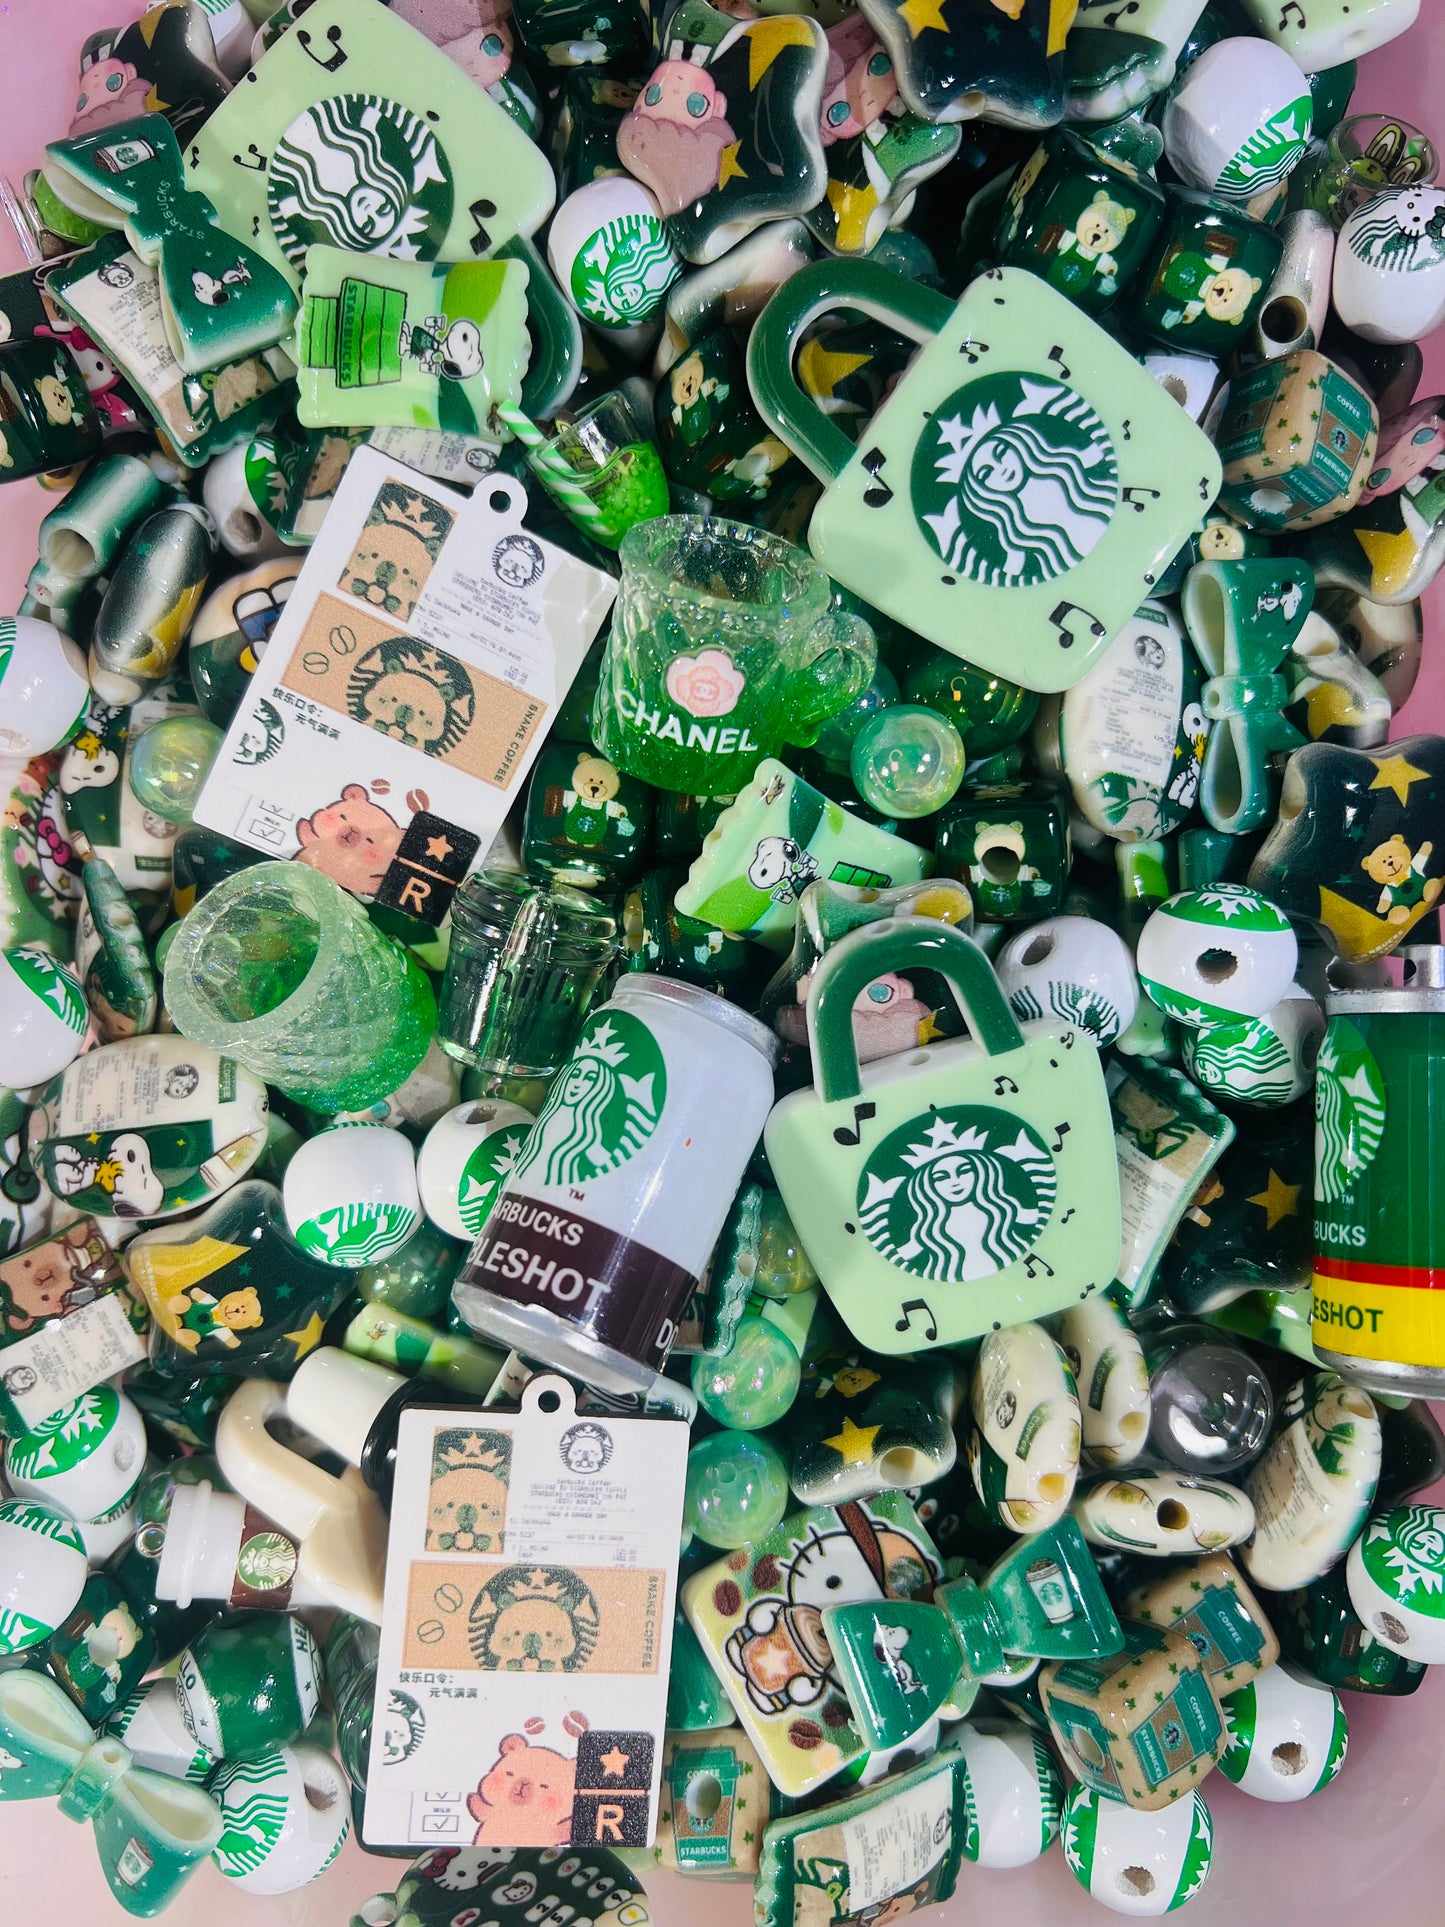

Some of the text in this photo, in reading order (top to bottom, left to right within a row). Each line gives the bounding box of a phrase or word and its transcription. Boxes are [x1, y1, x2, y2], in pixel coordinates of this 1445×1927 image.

[156, 180, 205, 240] STARBUCKS
[341, 284, 358, 382] STARBUCKS
[1335, 394, 1362, 418] COFFEE
[1315, 450, 1349, 482] STARBUCKS
[615, 688, 759, 754] CHANEL
[493, 741, 520, 783] COFFEE
[398, 875, 432, 914] R
[222, 1062, 232, 1099] COFFEE
[568, 1188, 586, 1202] TM
[1341, 1194, 1355, 1205] TM
[1312, 1219, 1367, 1248] BUCKS
[1217, 1610, 1242, 1644] COFFEE
[641, 1619, 656, 1668] COFFEE
[429, 1687, 478, 1699] 元气满满
[1189, 1696, 1208, 1732] COFFEE
[1139, 1728, 1164, 1780] STARBUCKS
[595, 1803, 626, 1841] R
[679, 1845, 728, 1857] STARBUCKS
[578, 1870, 592, 1881] 3
[595, 1881, 608, 1892] 6
[535, 1902, 550, 1914] 2
[611, 1892, 624, 1902] 9
[550, 1911, 564, 1924] 5
